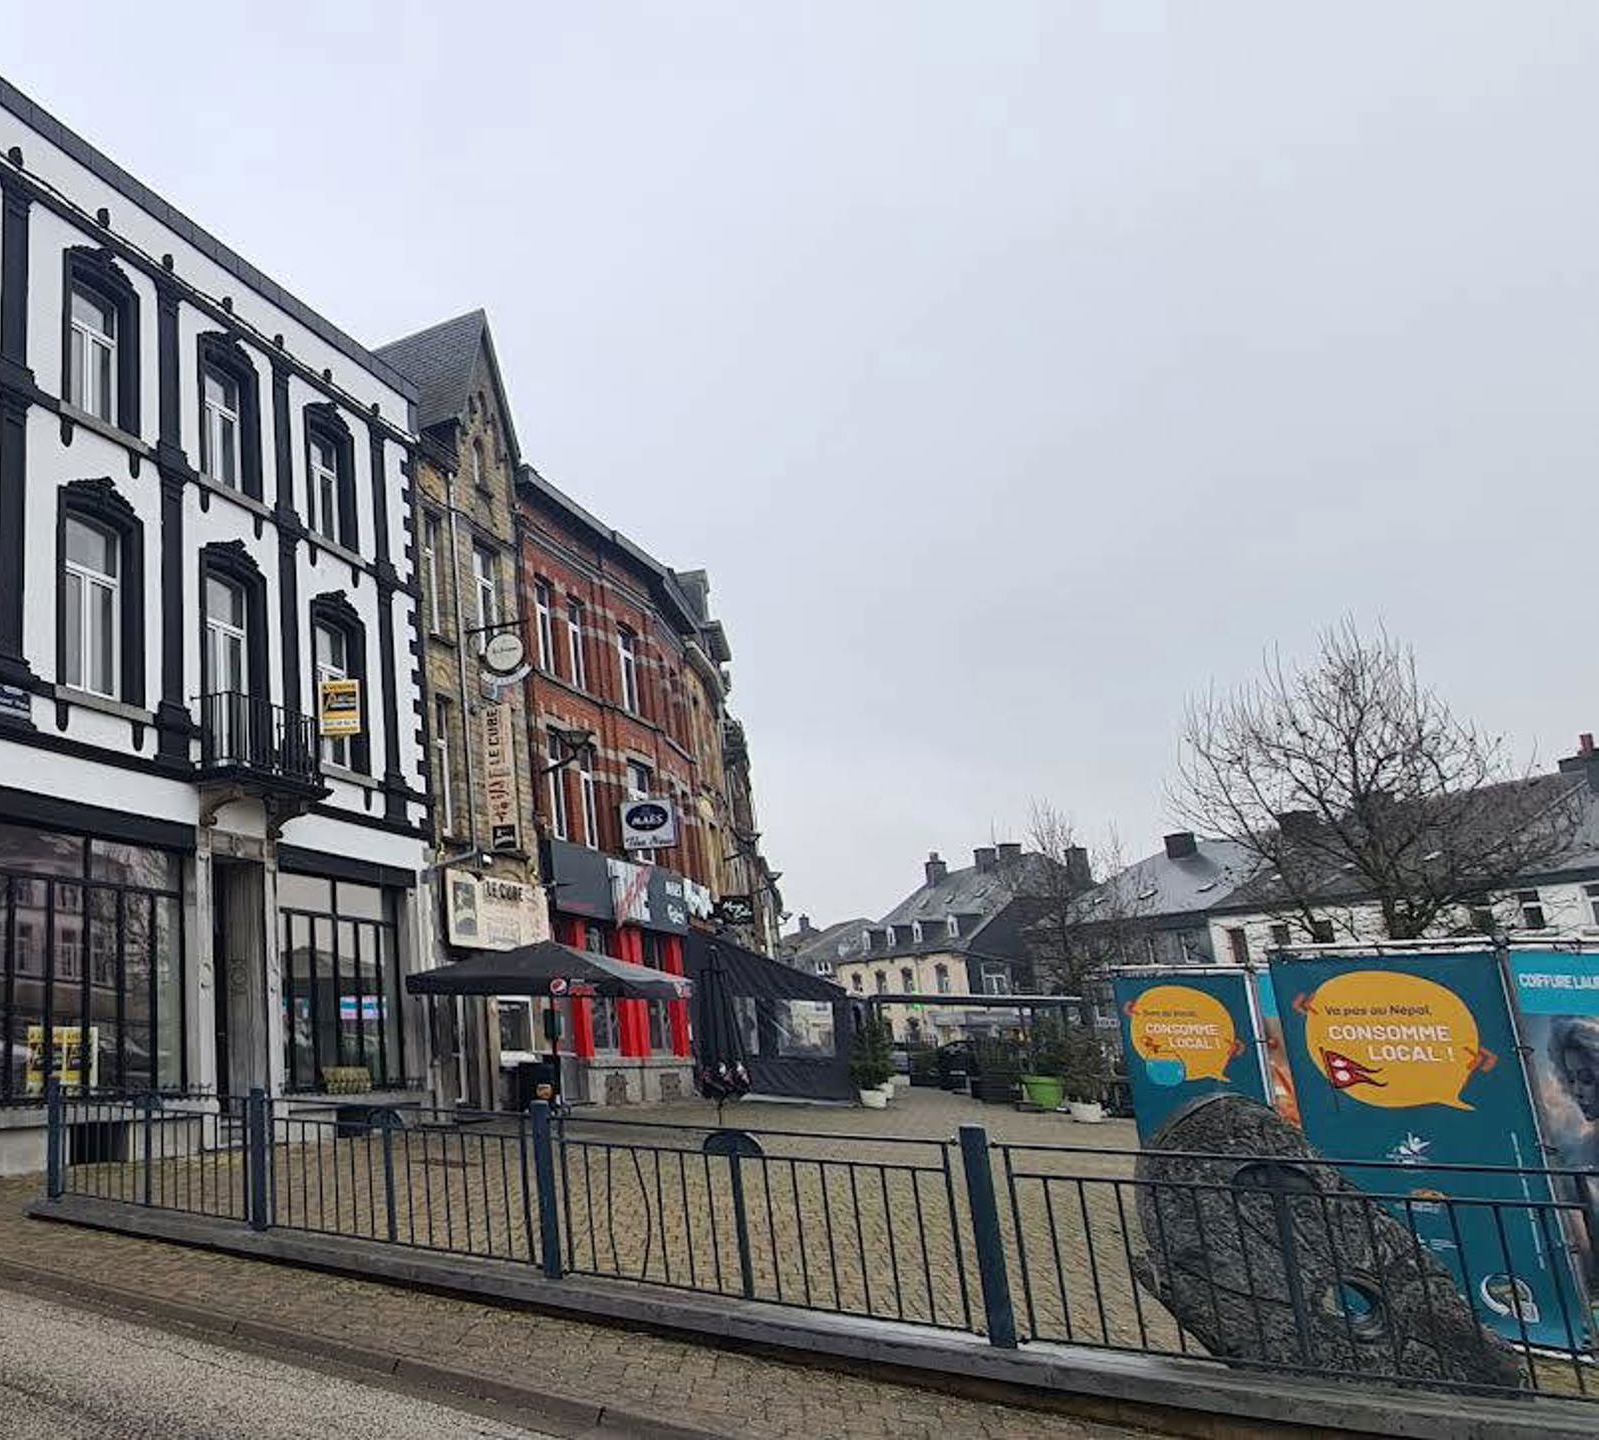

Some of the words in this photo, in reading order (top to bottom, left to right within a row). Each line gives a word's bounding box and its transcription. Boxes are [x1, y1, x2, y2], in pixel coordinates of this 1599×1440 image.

[486, 709, 499, 746] CUBE
[488, 749, 500, 766] LE
[630, 813, 664, 826] MAES
[485, 880, 498, 898] LE
[1517, 972, 1573, 989] COIFFURE
[1325, 1004, 1341, 1016] Va
[1343, 1006, 1367, 1018] pas
[1370, 1006, 1386, 1016] au
[1145, 1022, 1219, 1036] CONSOMME
[1327, 1024, 1452, 1041] CONSOMME
[1168, 1037, 1214, 1050] LOCAL
[1367, 1044, 1442, 1062] LOCAL
